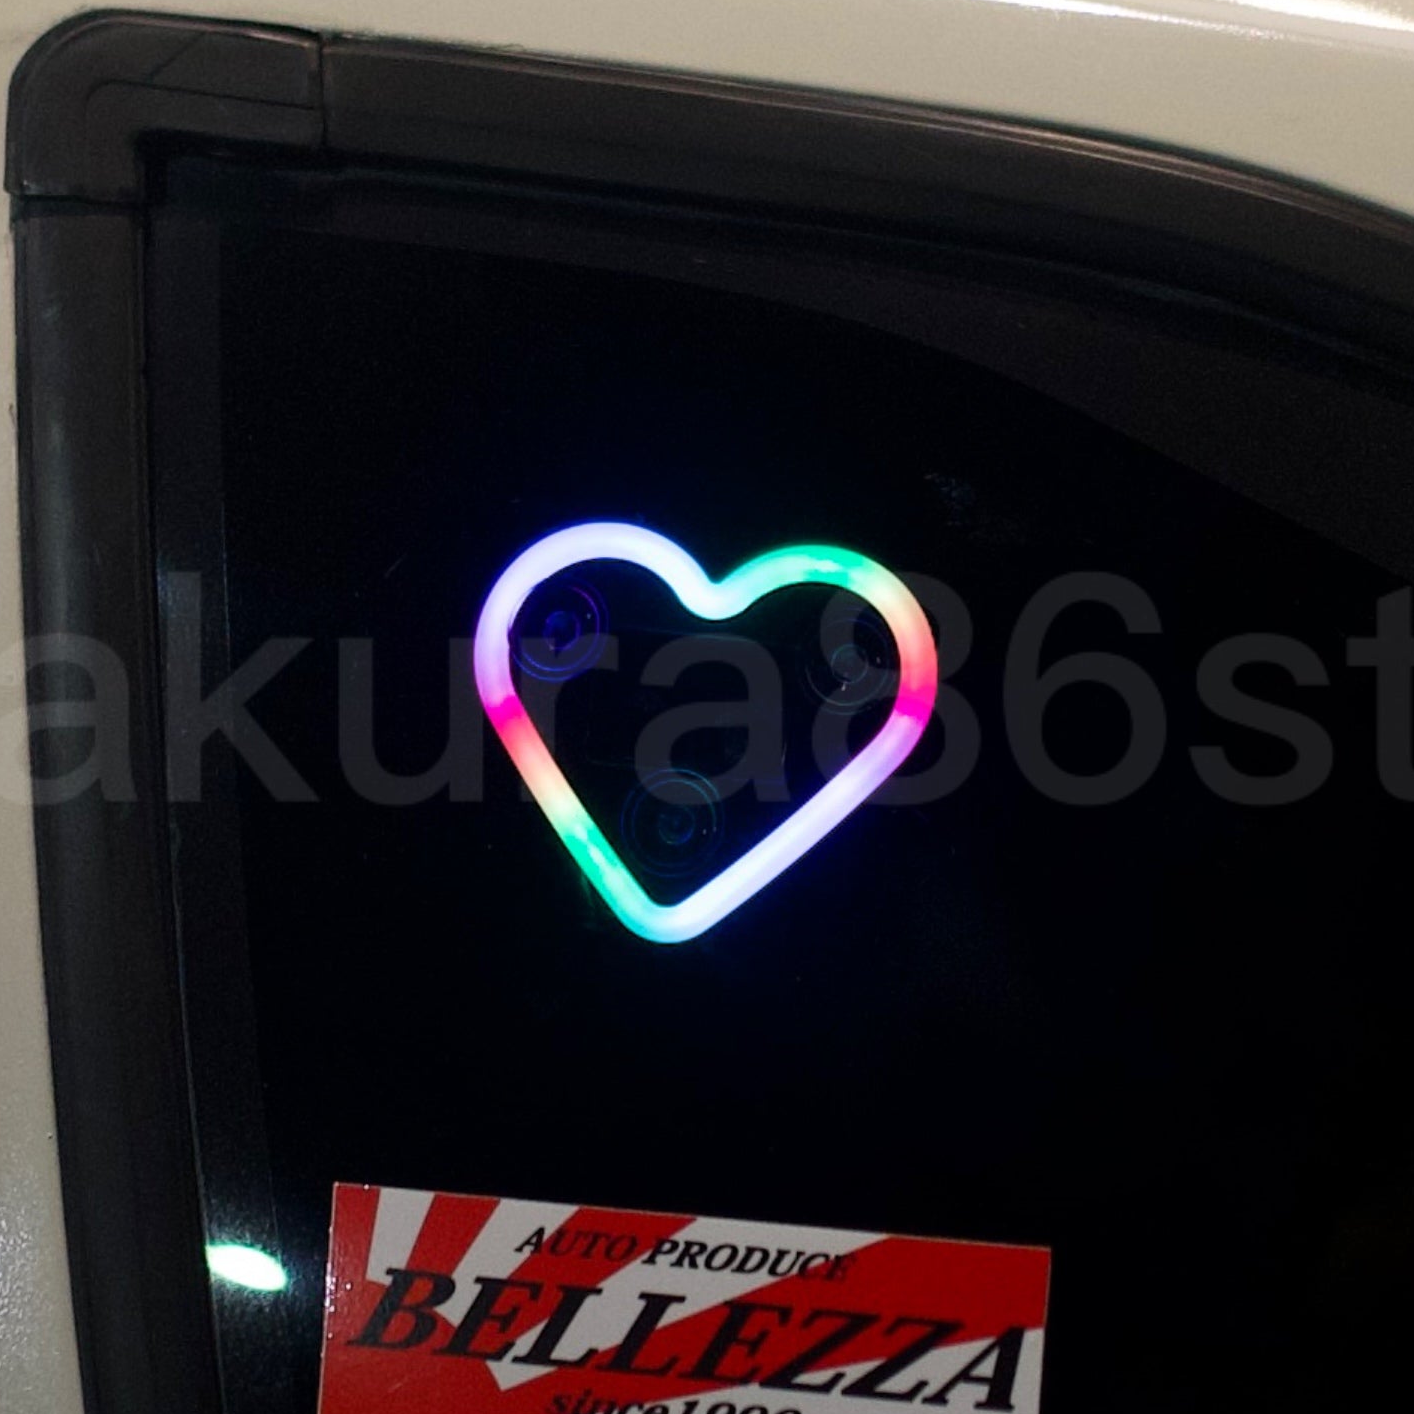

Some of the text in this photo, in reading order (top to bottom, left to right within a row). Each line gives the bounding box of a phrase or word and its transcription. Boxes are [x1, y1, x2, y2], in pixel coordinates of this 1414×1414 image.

[514, 1226, 854, 1282] AUTO PRODUCE
[346, 1267, 1025, 1412] BELLEZZA
